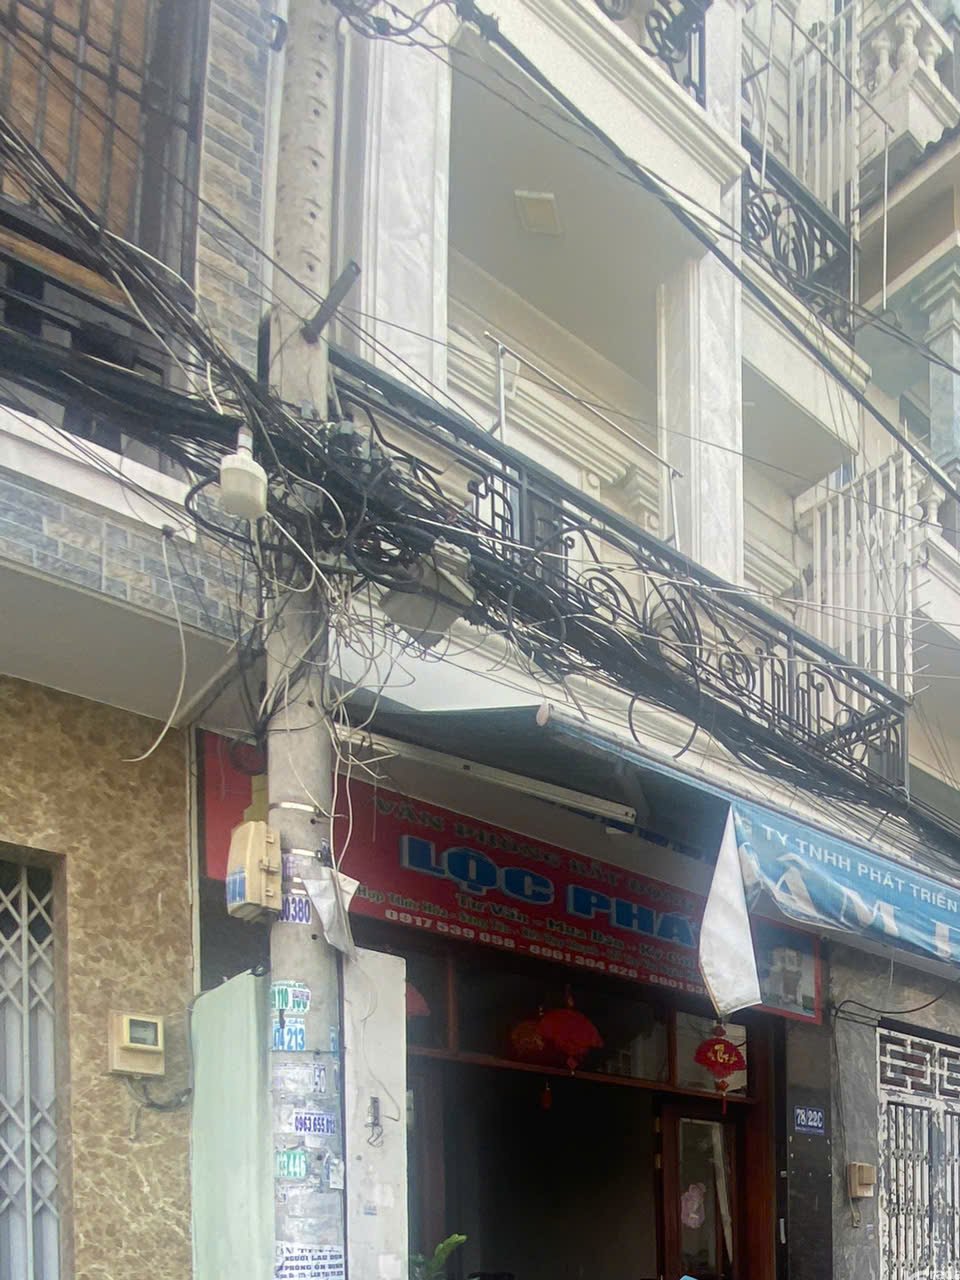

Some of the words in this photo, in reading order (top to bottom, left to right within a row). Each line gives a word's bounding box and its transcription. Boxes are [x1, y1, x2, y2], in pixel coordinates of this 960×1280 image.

[761, 824, 789, 847] TY
[796, 838, 850, 872] TNHH
[858, 863, 906, 892] PHÁT
[384, 909, 433, 928] 0917
